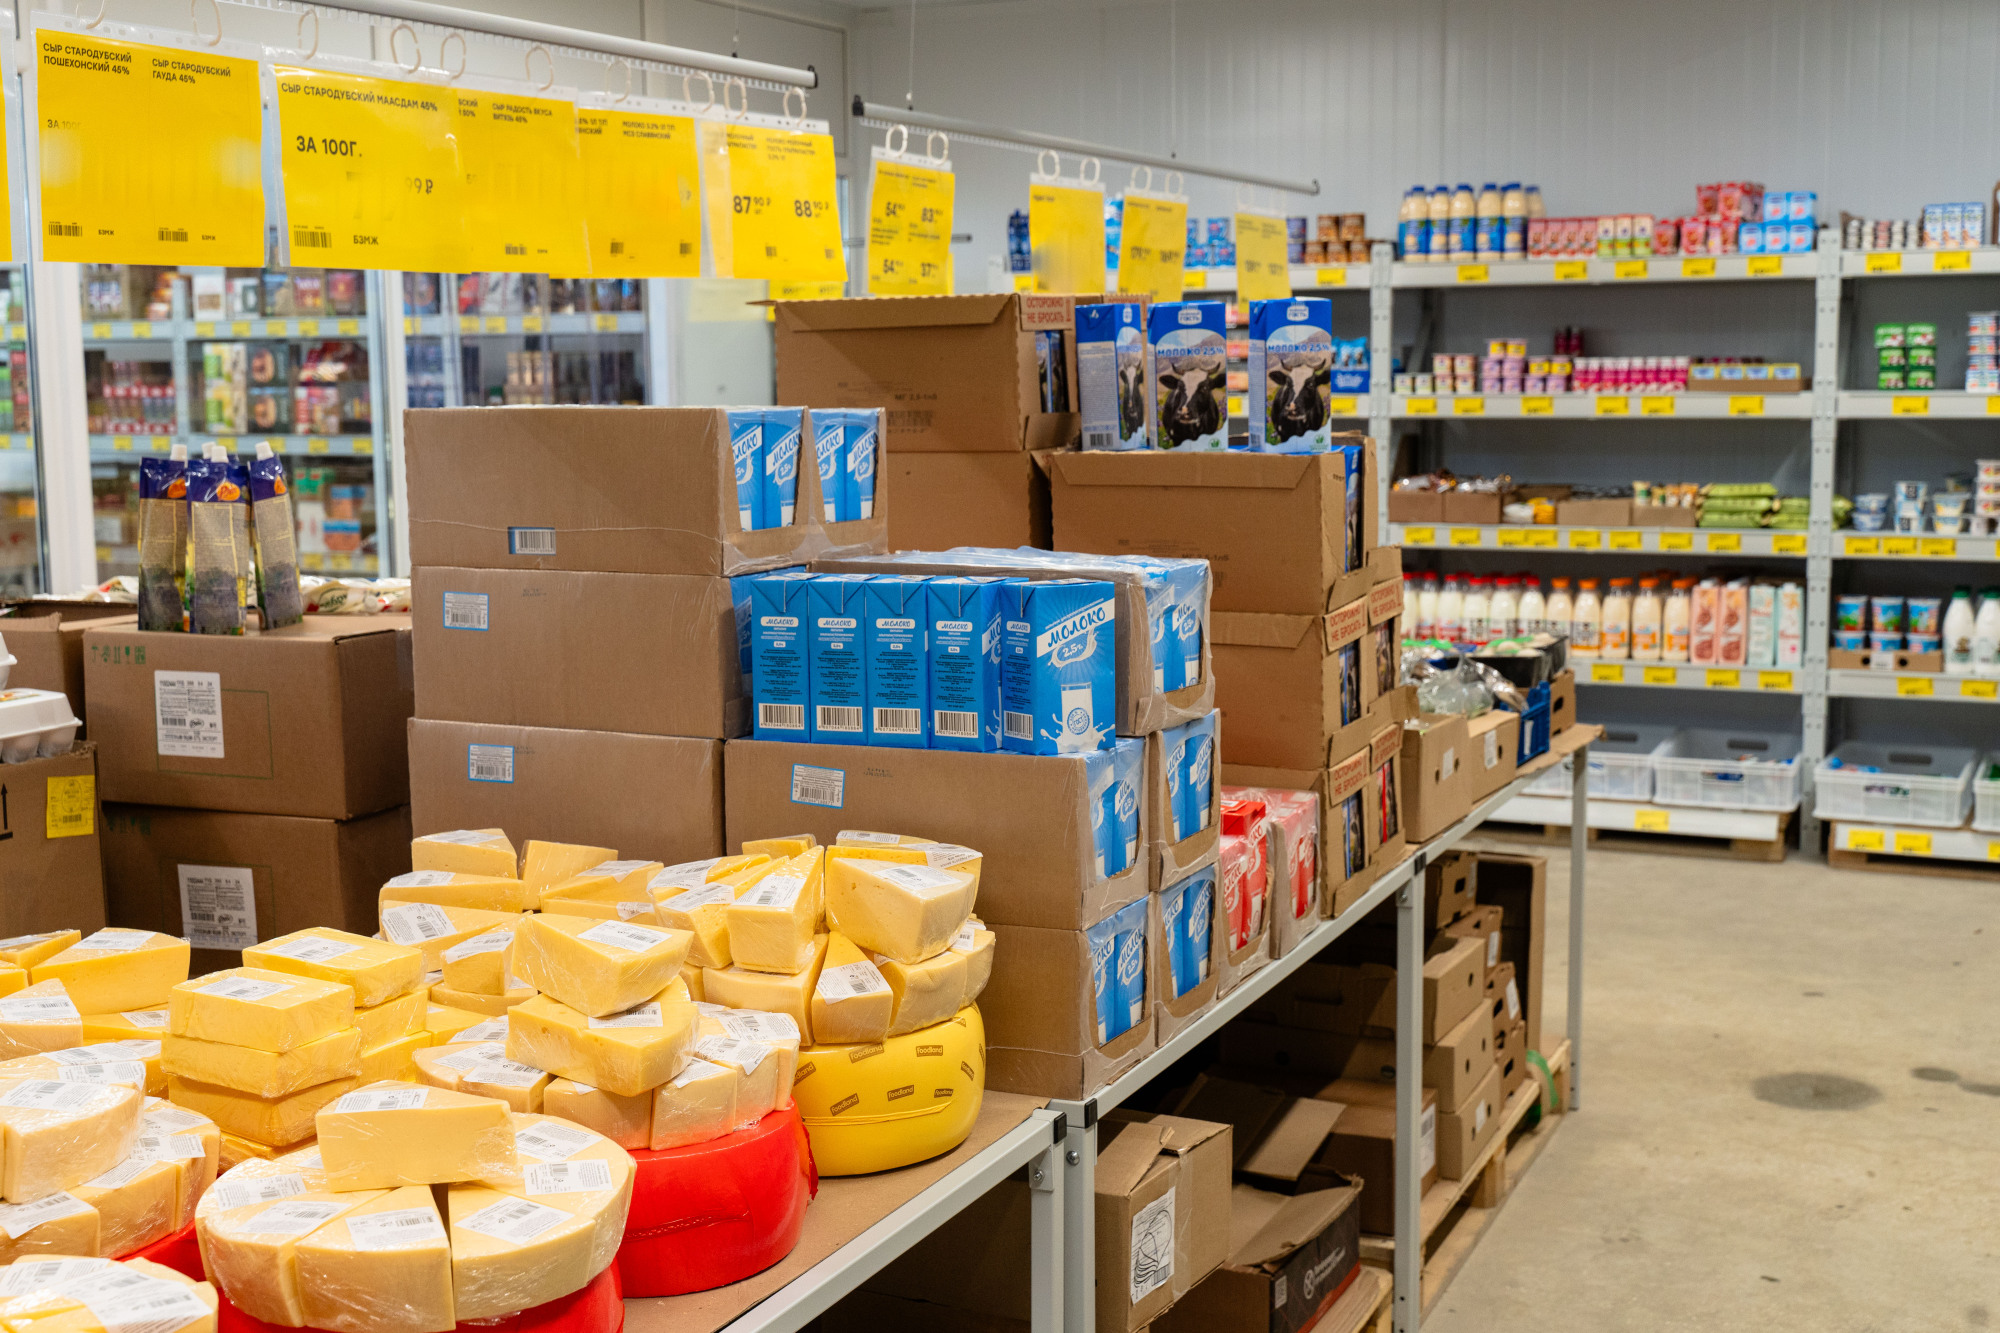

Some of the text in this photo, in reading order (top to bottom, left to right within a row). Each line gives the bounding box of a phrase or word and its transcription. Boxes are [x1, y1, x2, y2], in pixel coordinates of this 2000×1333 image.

[43, 43, 132, 63] СЫР СТАРОДУБСКИЙ
[44, 56, 130, 75] ПОШЕХОНСКИЙ 45%
[152, 58, 231, 77] СЫР СТАРОДУБСКИЙ
[152, 70, 196, 84] ГАУДА 45%
[281, 83, 301, 93] СЫР
[303, 86, 375, 103] СТАРОДУБСКИЙ
[377, 95, 419, 109] МААСДАМ
[47, 119, 60, 129] ЗА
[296, 135, 317, 153] ЗА
[733, 195, 751, 214] 87
[794, 199, 812, 218] 88
[353, 235, 379, 246] БЗМЖ
[1027, 312, 1064, 323] НЕ БРОСАТЬ
[766, 618, 794, 626] МОЛОКО
[823, 619, 852, 627] МОЛОКО
[882, 620, 911, 628] МОЛОКО
[941, 623, 969, 631] МОЛОКО
[1010, 623, 1028, 632] МОЛОКО
[1048, 607, 1105, 648] МОЛОКО
[1331, 630, 1339, 642] НЕ
[1063, 643, 1084, 658] 2,5%
[851, 1044, 883, 1060] foodland
[917, 1046, 942, 1054] foodland
[795, 1063, 814, 1080] dland
[888, 1086, 914, 1099] foodland
[831, 1095, 859, 1114] foodland
